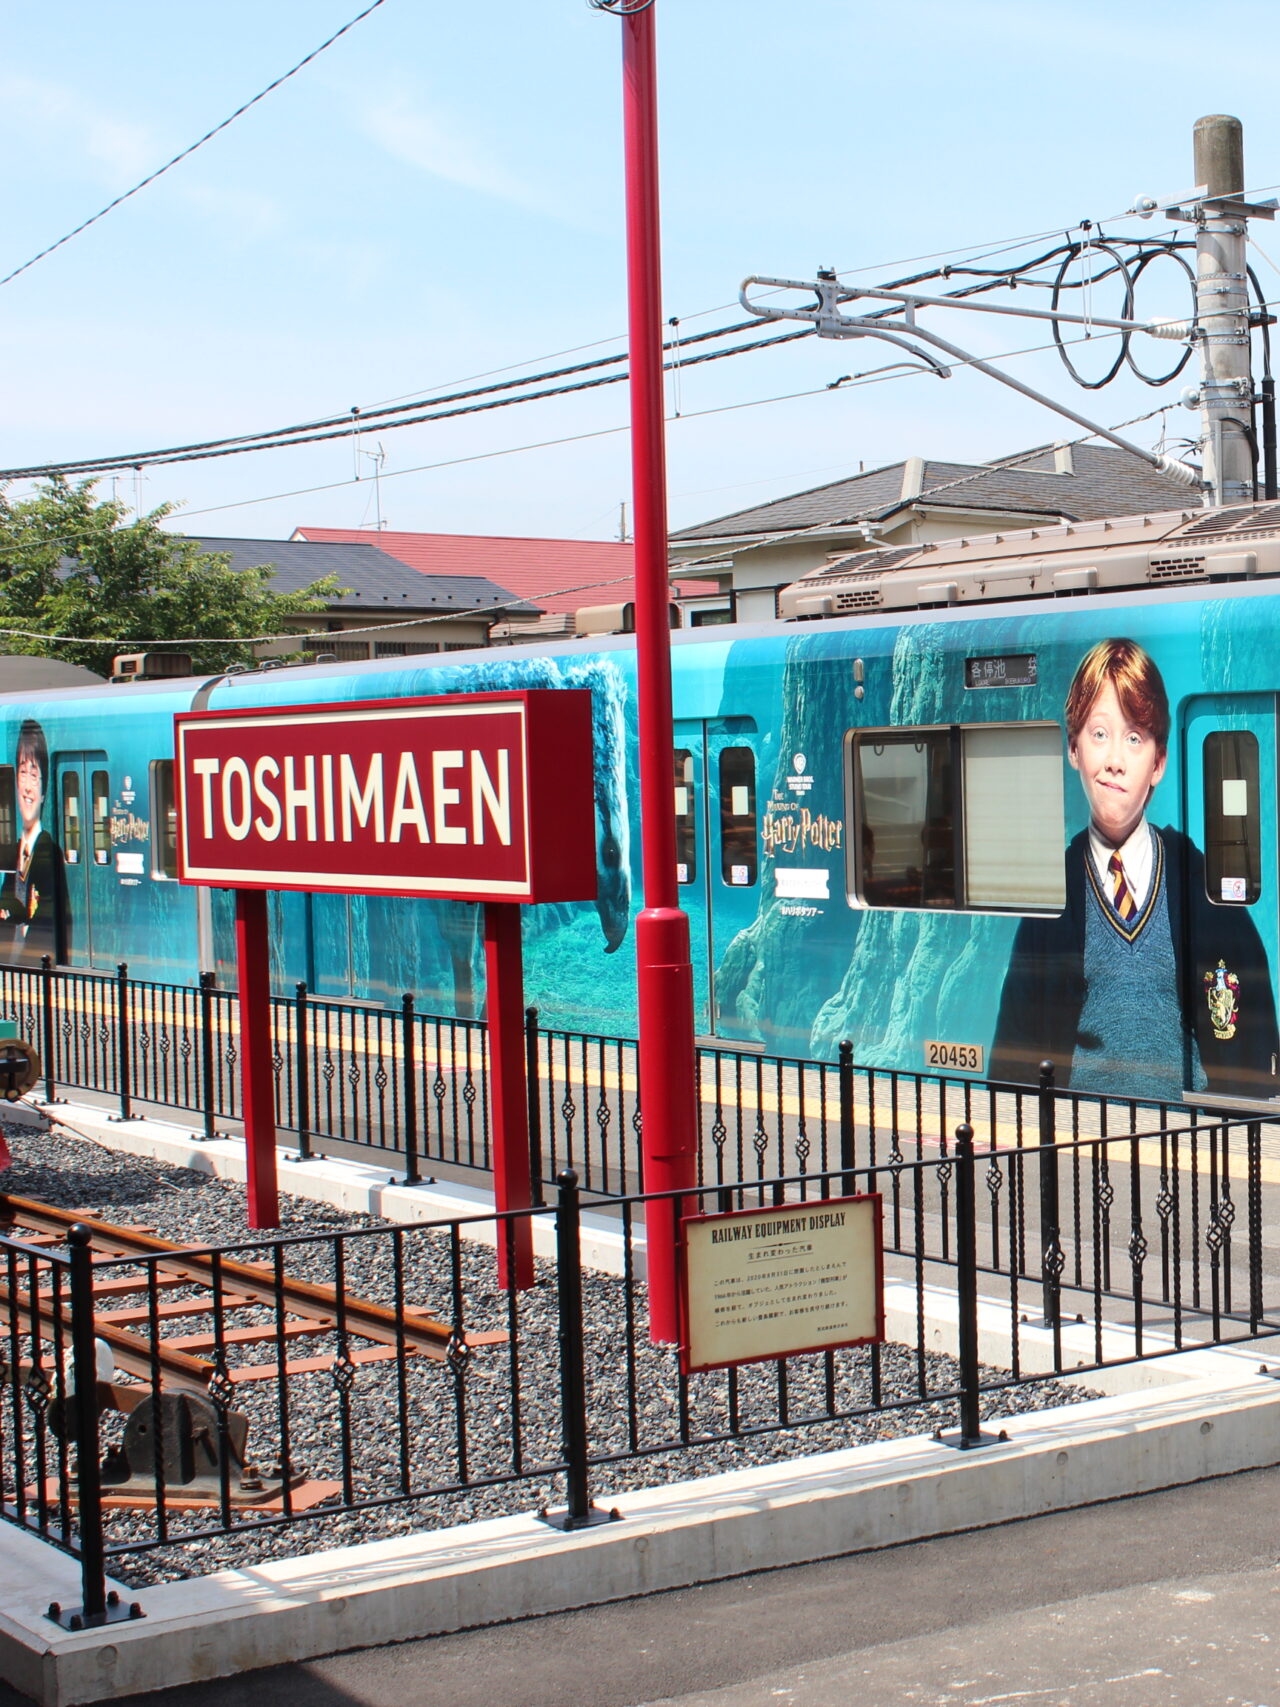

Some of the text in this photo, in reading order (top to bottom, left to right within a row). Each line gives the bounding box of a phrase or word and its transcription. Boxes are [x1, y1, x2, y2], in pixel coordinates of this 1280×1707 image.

[193, 749, 512, 846] TOSHIMAEN
[761, 807, 843, 858] Harry Potter
[930, 1044, 977, 1068] 20453
[711, 1211, 846, 1244] RAILWAY EQUIPMENT DISPLAY
